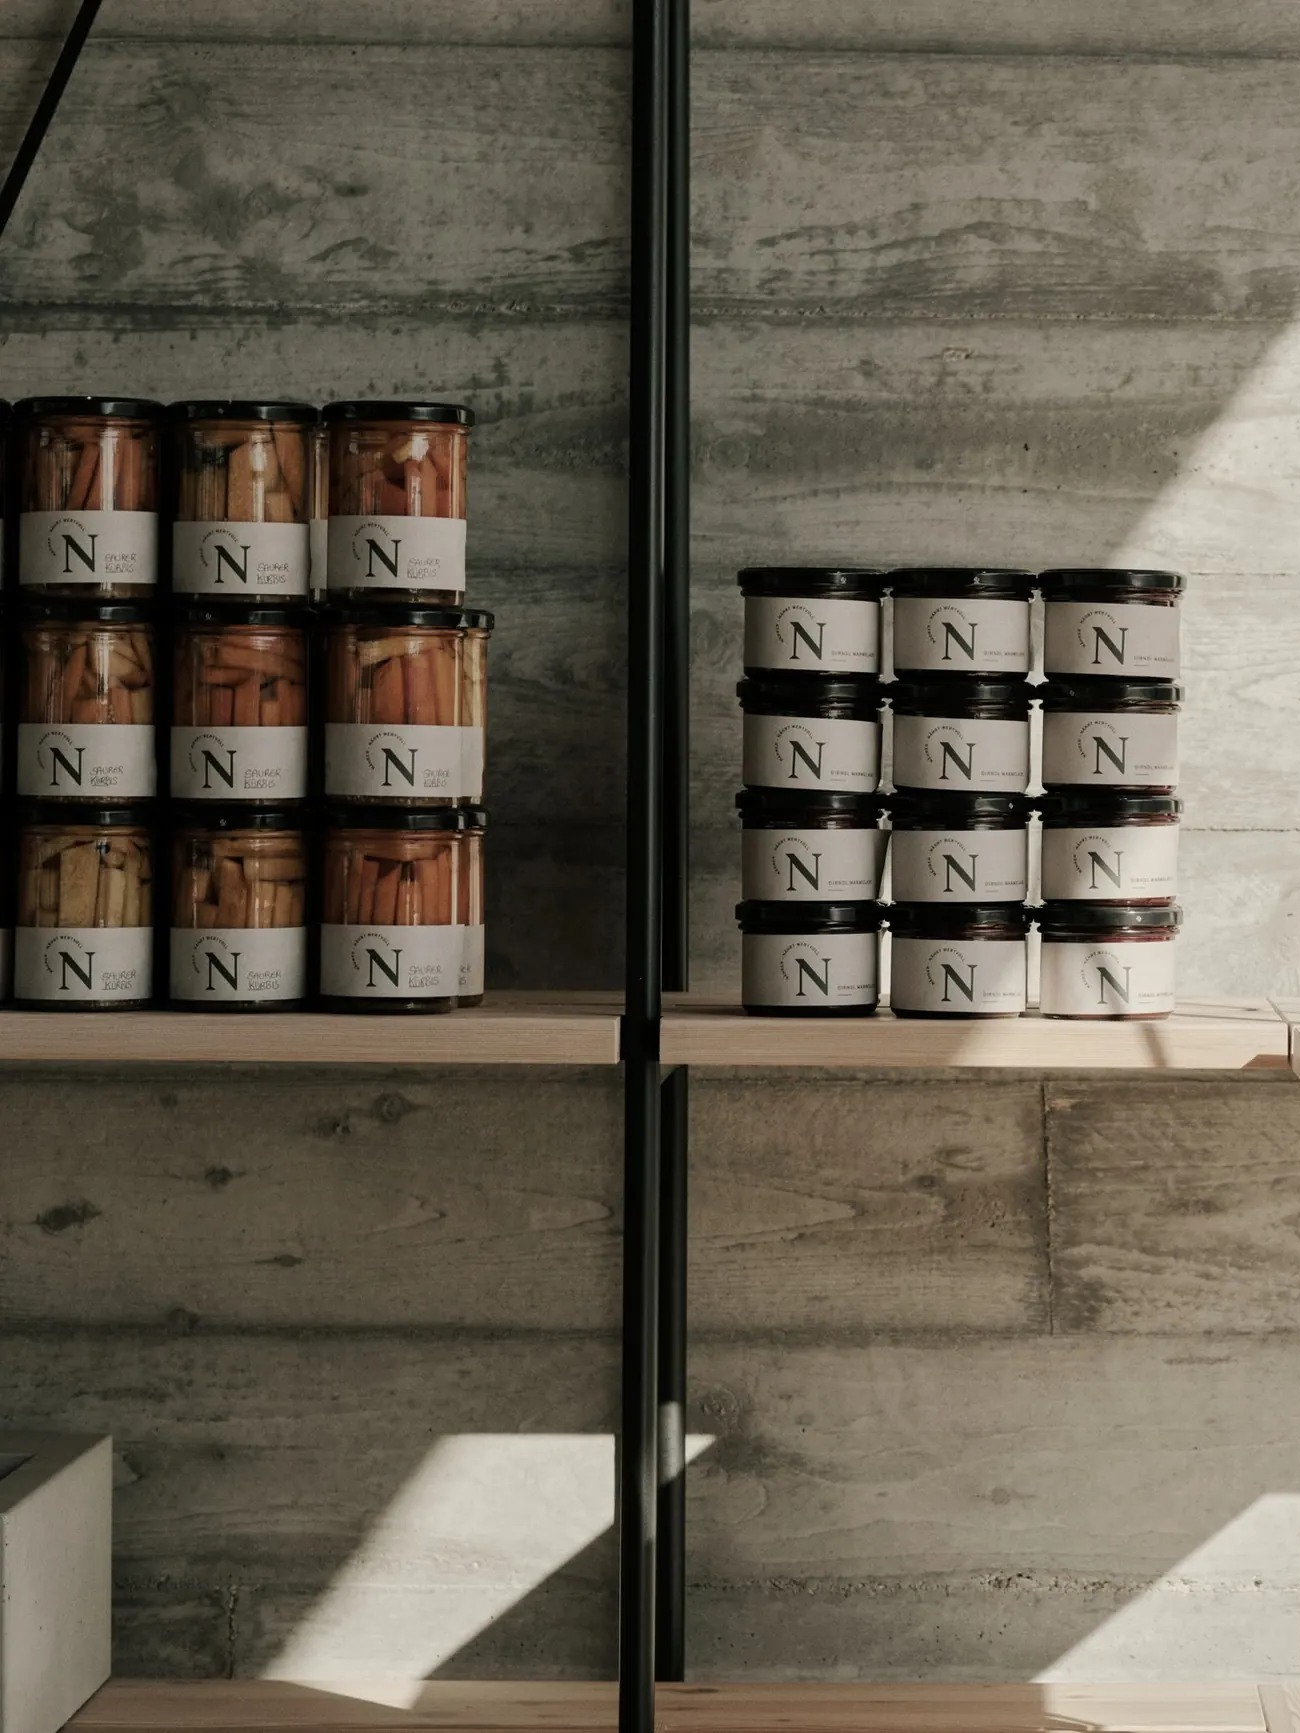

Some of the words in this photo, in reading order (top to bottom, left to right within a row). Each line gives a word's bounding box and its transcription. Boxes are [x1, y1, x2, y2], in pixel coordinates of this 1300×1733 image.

[61, 534, 99, 572] N
[214, 545, 252, 584] N
[365, 539, 402, 578] N
[789, 621, 827, 660] N
[941, 622, 978, 661] N
[1092, 626, 1129, 665] N
[49, 747, 86, 786] N
[201, 750, 237, 788] N
[381, 748, 419, 787] N
[788, 740, 826, 780] N
[938, 741, 977, 781] N
[1092, 736, 1130, 775] N
[785, 853, 822, 891] N
[942, 854, 979, 893] N
[1087, 851, 1125, 889] N
[58, 952, 96, 990] N
[204, 952, 241, 991] N
[365, 949, 403, 987] N
[794, 958, 833, 996] N
[940, 964, 978, 1002] N
[1095, 966, 1133, 1004] N
